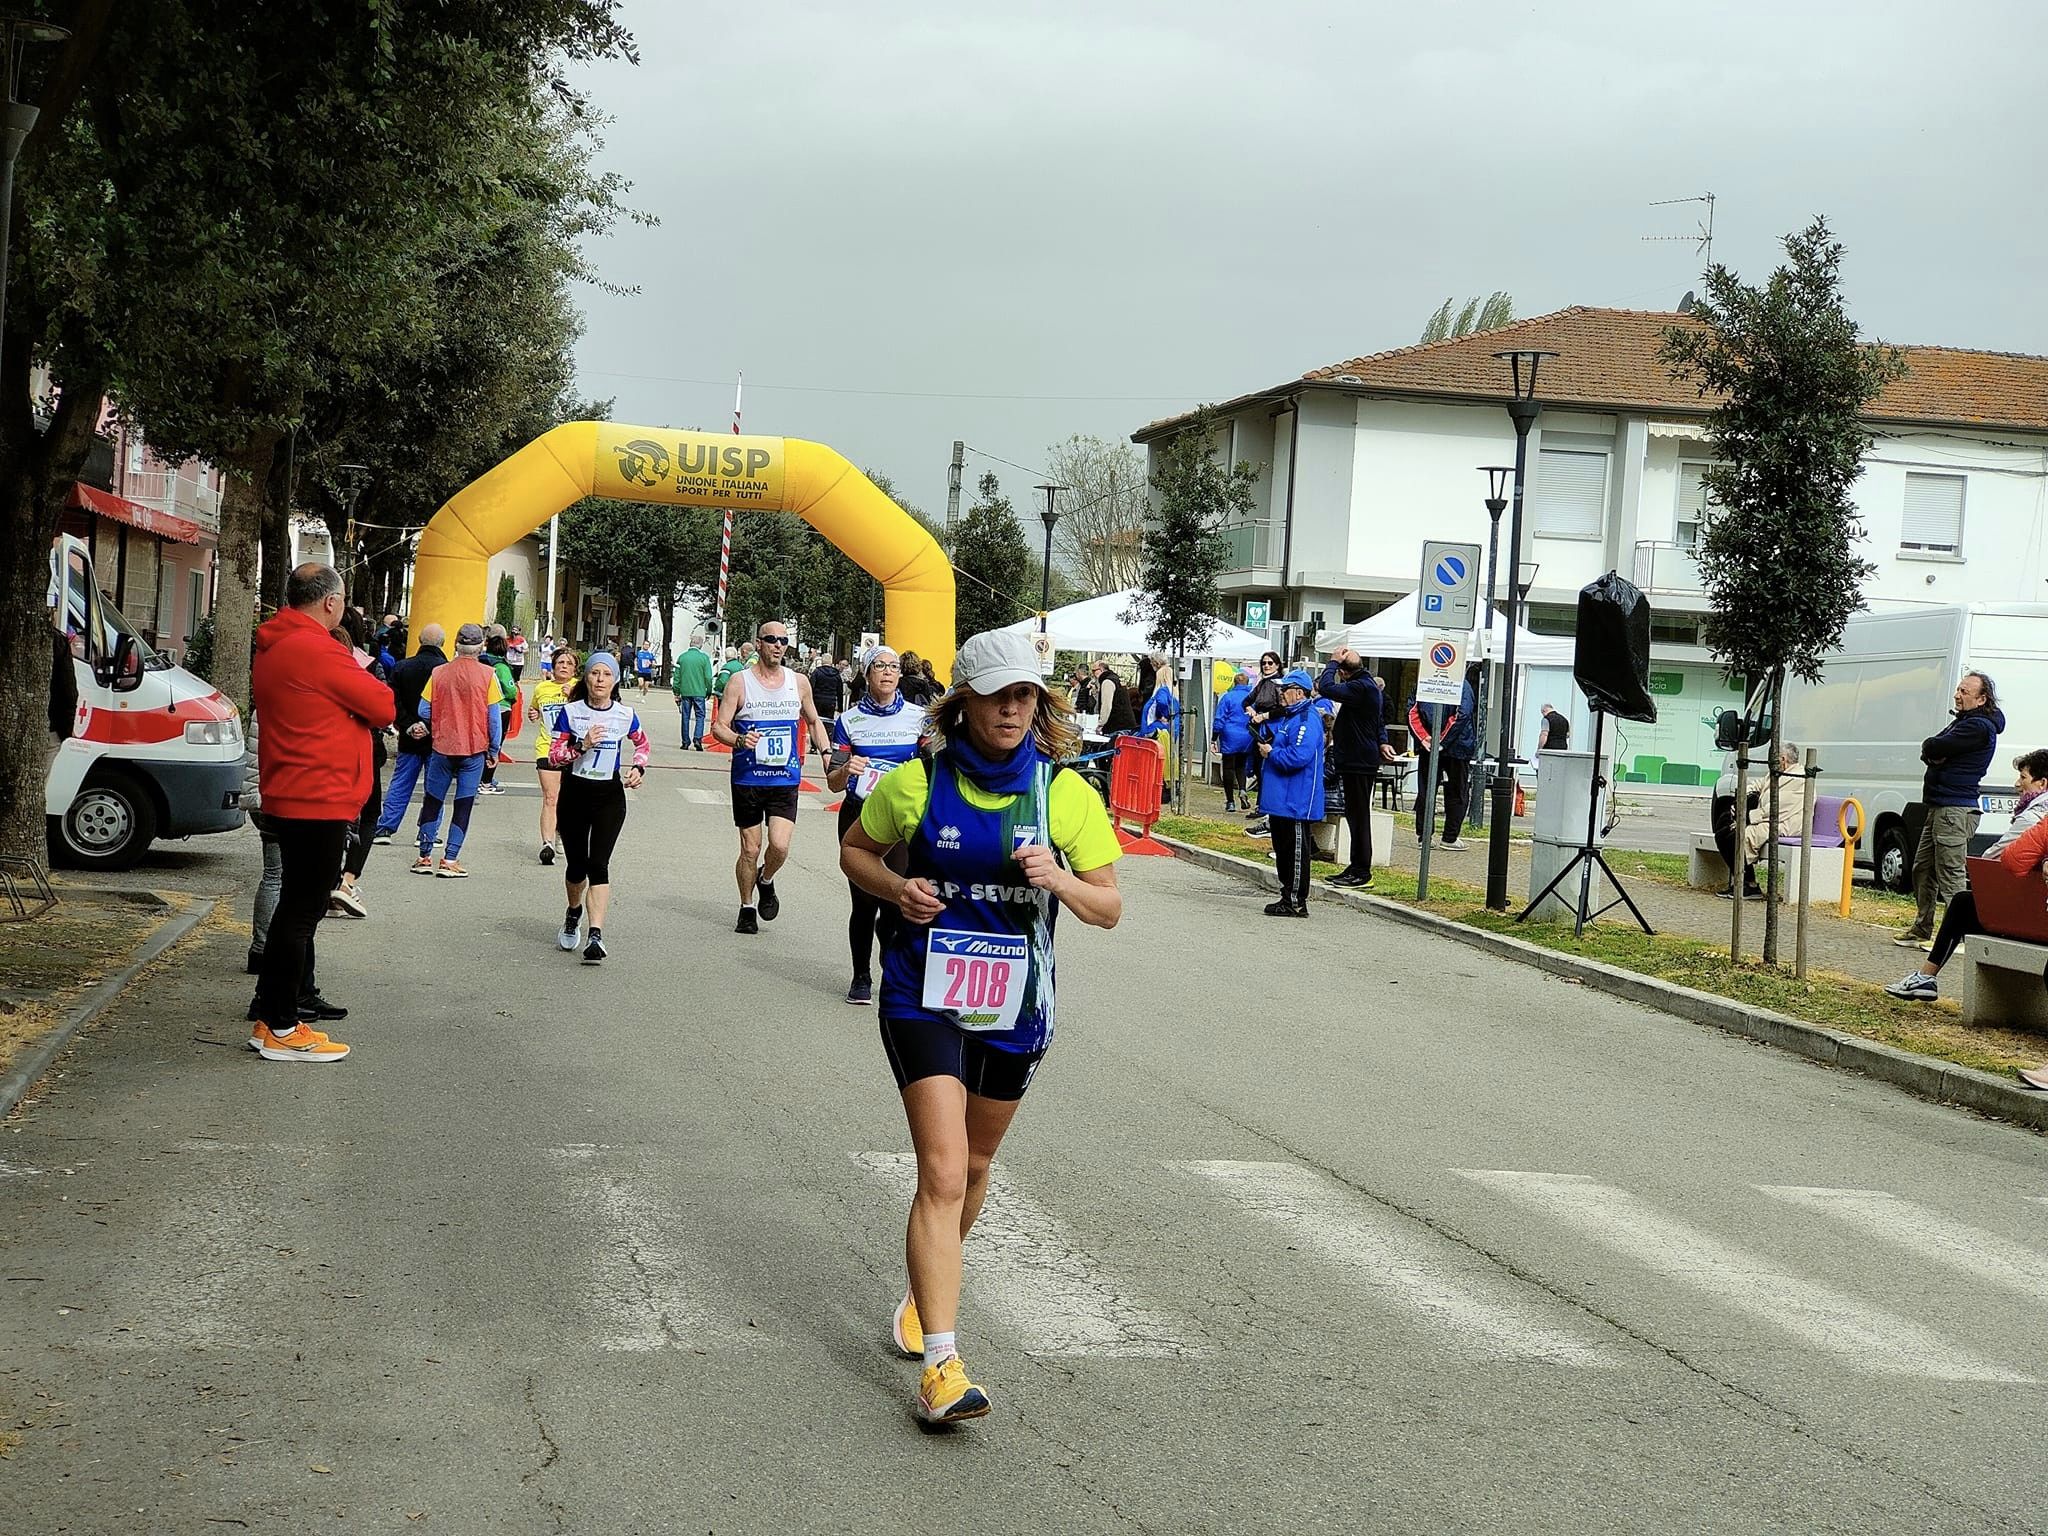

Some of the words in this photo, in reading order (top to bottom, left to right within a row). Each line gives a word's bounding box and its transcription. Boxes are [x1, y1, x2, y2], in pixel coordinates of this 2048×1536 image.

[678, 443, 771, 478] UISP
[676, 476, 717, 488] UNIONE
[721, 479, 769, 491] ITALIANA
[675, 486, 708, 496] SPORT
[712, 489, 730, 498] PER
[735, 491, 762, 500] TUTTI
[1427, 597, 1439, 610] P
[745, 701, 800, 709] QUADRILATERO
[768, 737, 784, 756] 83
[592, 750, 601, 768] 7
[1990, 798, 2003, 810] EA
[937, 839, 960, 850] errea
[970, 883, 1041, 904] SEVEN
[965, 940, 1025, 956] MIZUNO
[943, 957, 1010, 1008] 208
